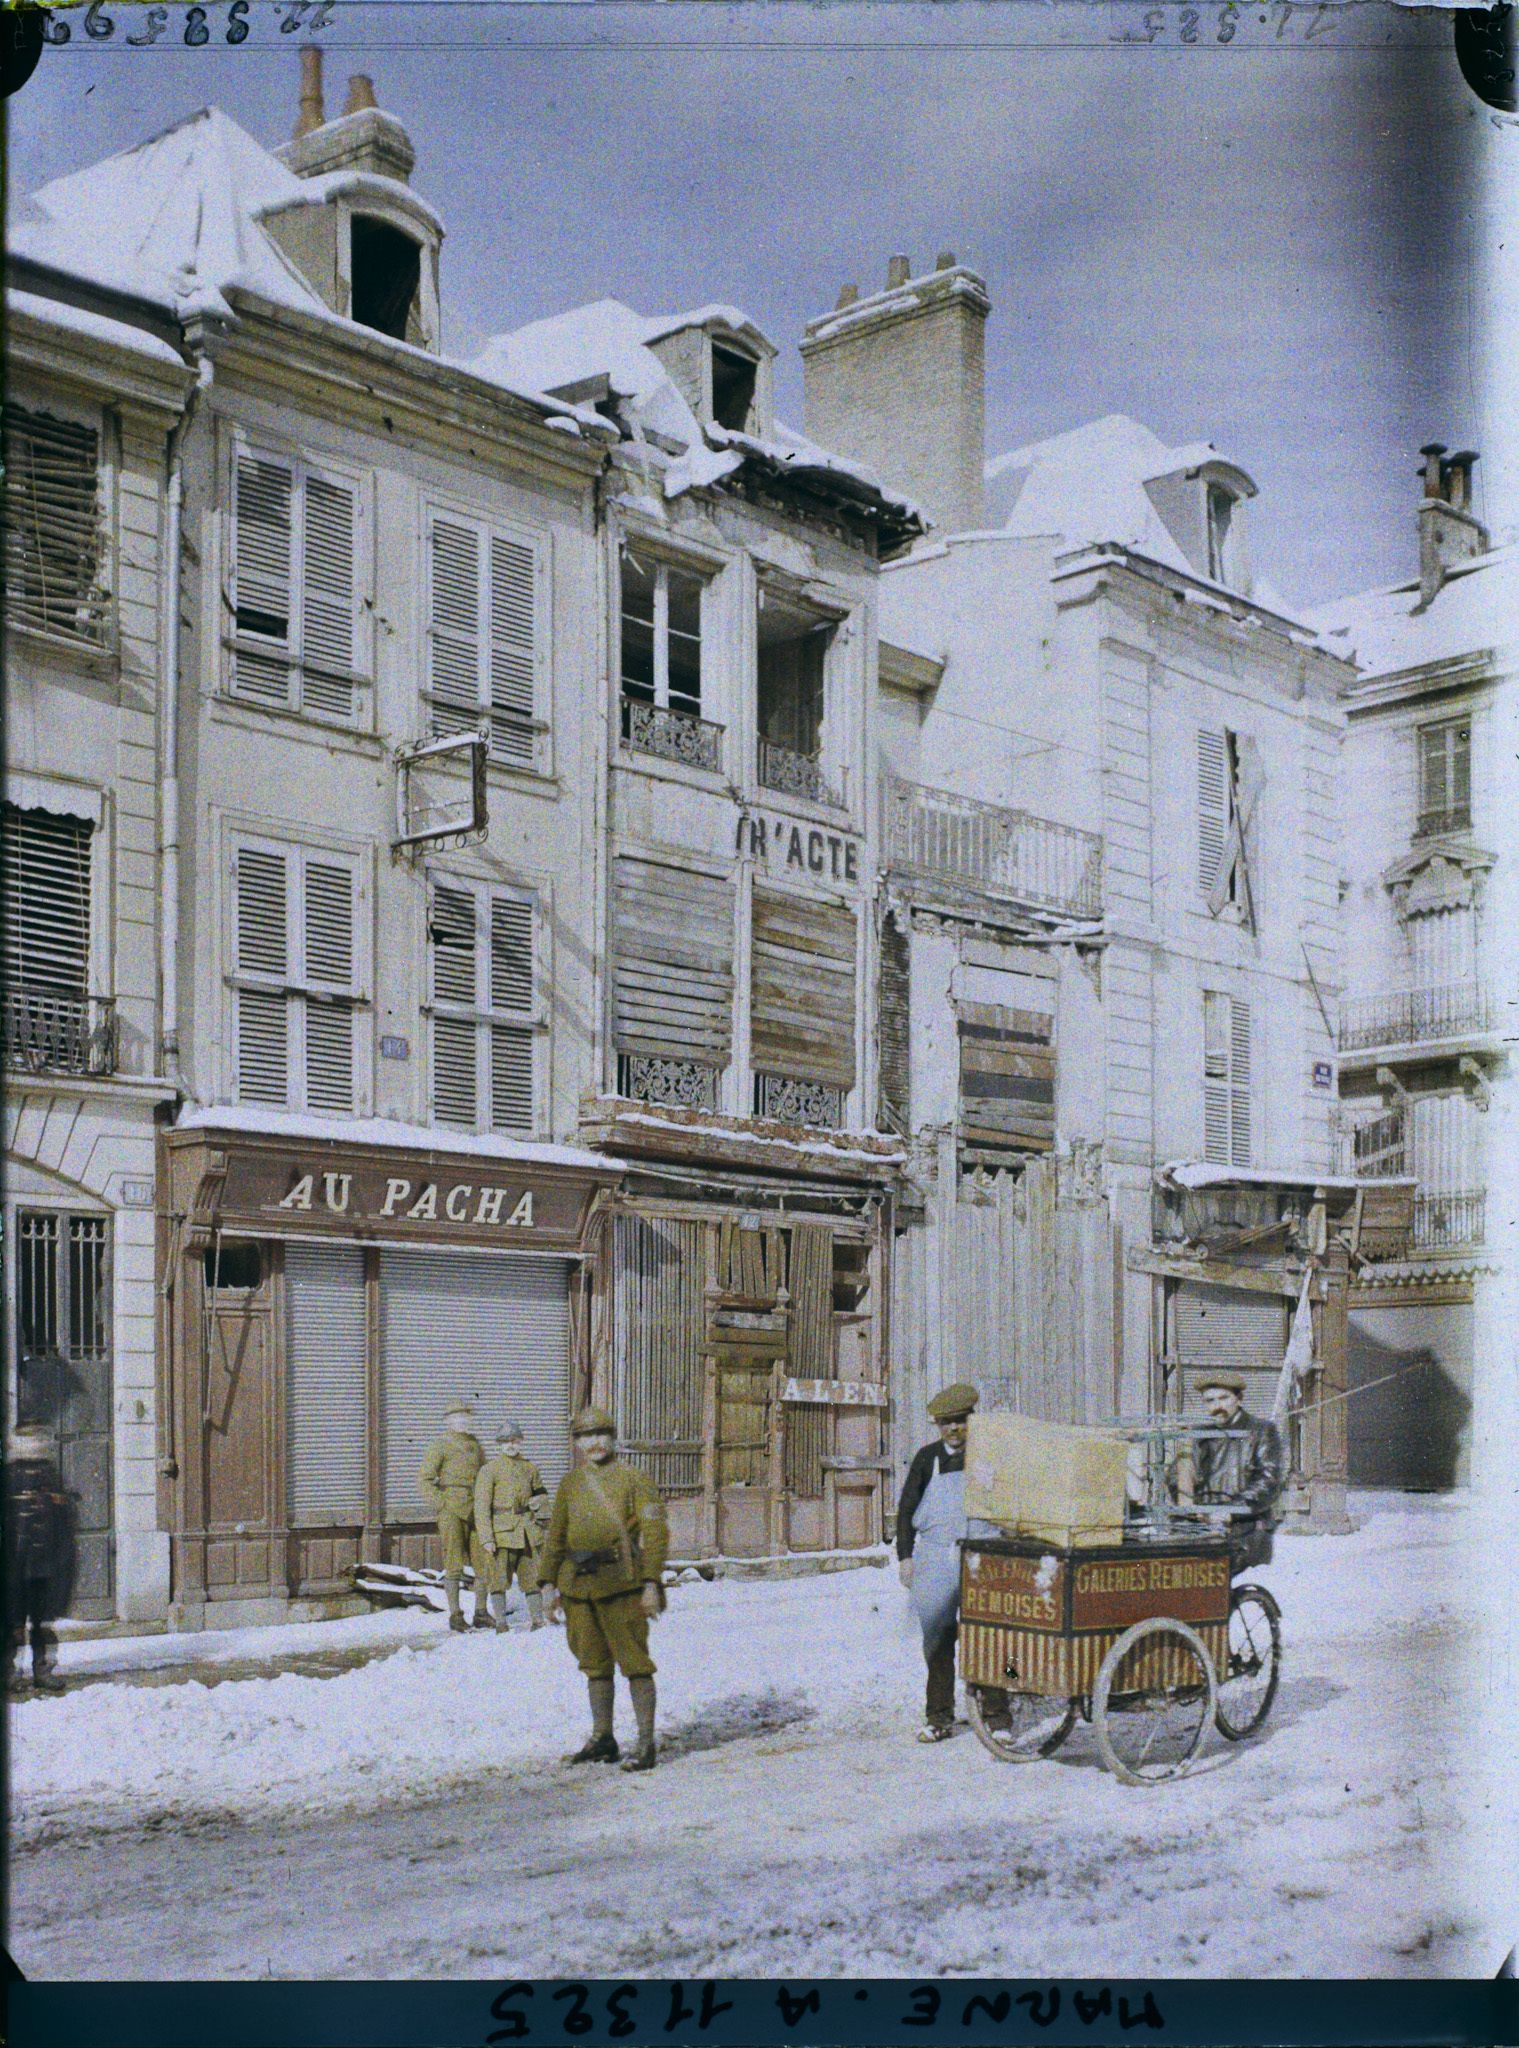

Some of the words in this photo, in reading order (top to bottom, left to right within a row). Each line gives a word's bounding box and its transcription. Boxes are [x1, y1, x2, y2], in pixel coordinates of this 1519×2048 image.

[279, 1172, 352, 1212] AU
[379, 1177, 535, 1228] PACHA
[782, 1377, 802, 1402] A
[812, 1379, 888, 1406] L'EN
[1076, 1563, 1148, 1594] GALERIES
[1150, 1560, 1227, 1591] REMOISES
[963, 1586, 1058, 1622] REMOISES
